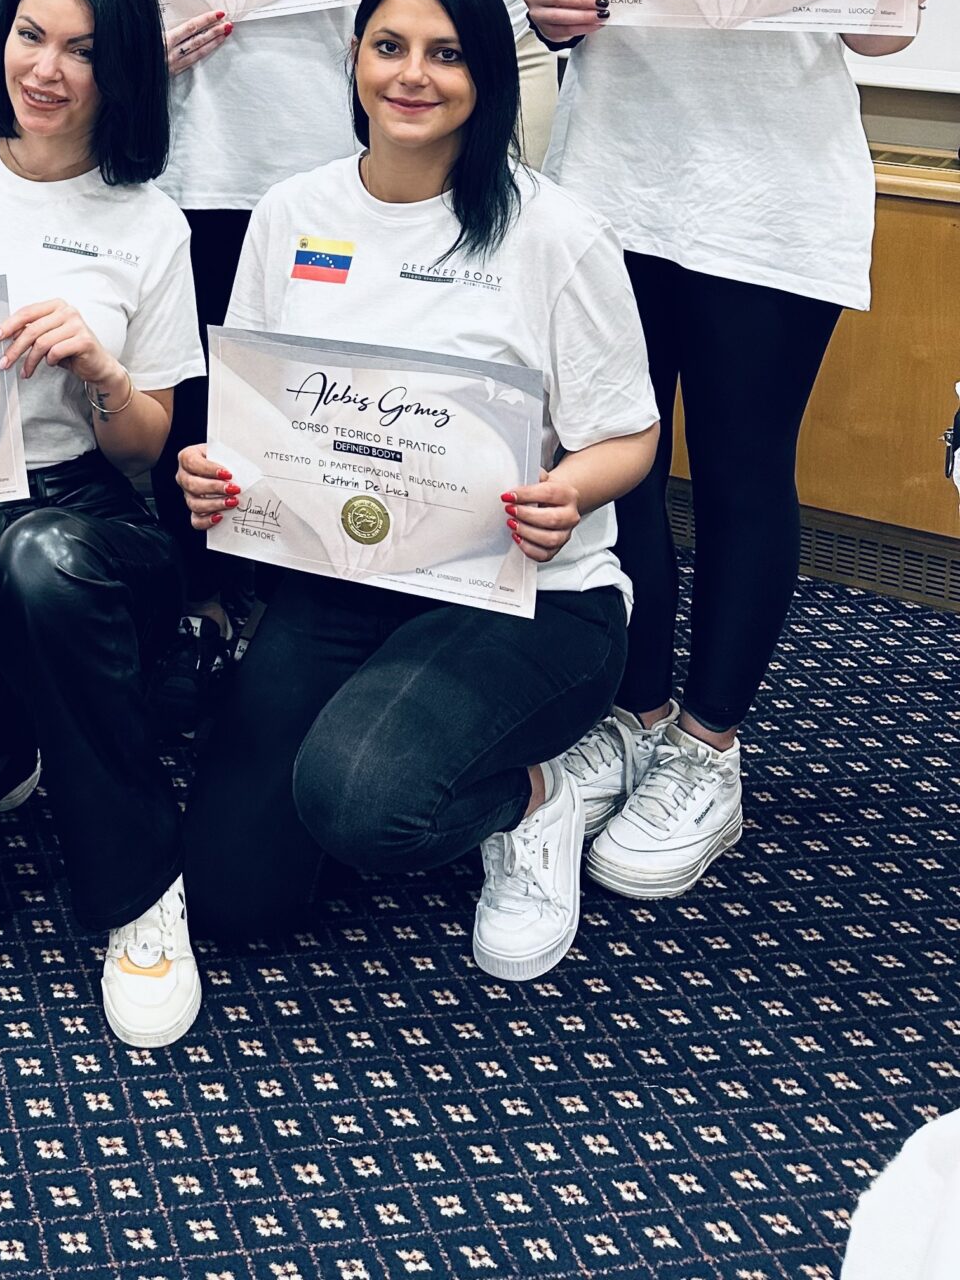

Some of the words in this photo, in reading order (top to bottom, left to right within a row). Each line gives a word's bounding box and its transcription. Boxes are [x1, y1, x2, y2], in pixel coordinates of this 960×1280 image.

[44, 235, 99, 252] DEFINED
[107, 248, 140, 262] BODY
[401, 262, 457, 277] DEFINED
[464, 270, 503, 284] BODY
[285, 370, 370, 416] Alebis
[378, 386, 450, 427] Gomez
[291, 419, 329, 436] CORSO
[333, 426, 382, 445] TEORICO
[386, 435, 394, 446] E
[398, 437, 447, 455] PRATICO
[335, 441, 370, 456] DEFINED
[264, 449, 311, 466] ATTESTATO
[318, 459, 327, 468] DI
[330, 461, 401, 482] PARTECIPAZIONE
[408, 475, 457, 491] RILASCIATO
[240, 528, 275, 541] RELATORE
